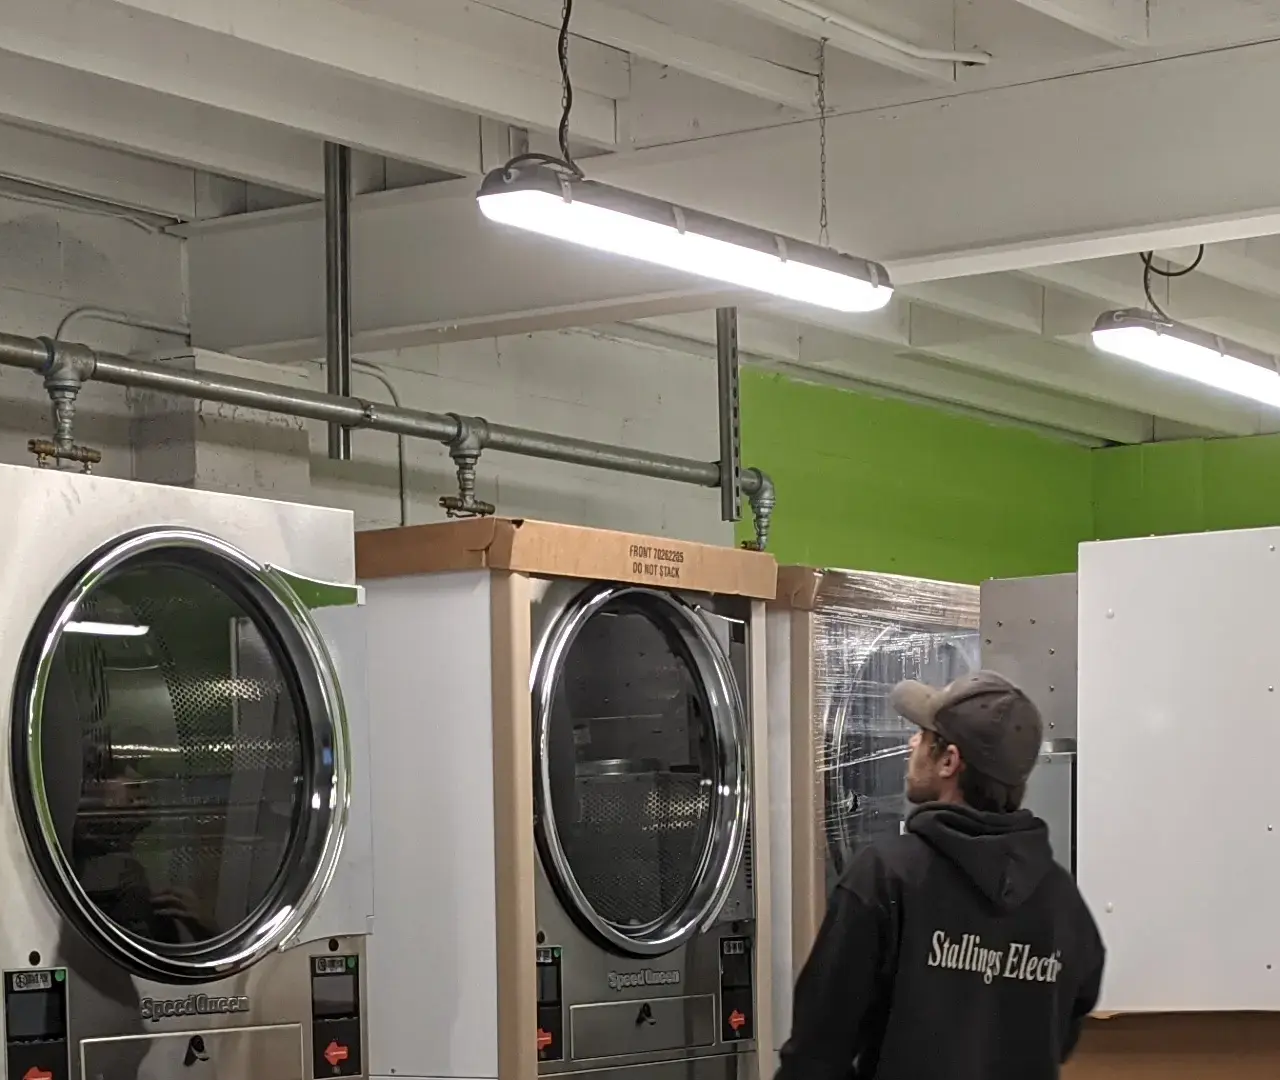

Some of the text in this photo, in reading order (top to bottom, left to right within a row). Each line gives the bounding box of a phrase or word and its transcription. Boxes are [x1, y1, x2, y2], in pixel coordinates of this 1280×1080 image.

[629, 544, 652, 559] FRONT
[632, 561, 680, 579] DO NOT STACK
[928, 930, 1003, 985] Stallings
[607, 968, 645, 992] Speed
[141, 993, 250, 1022] Speed Queen
